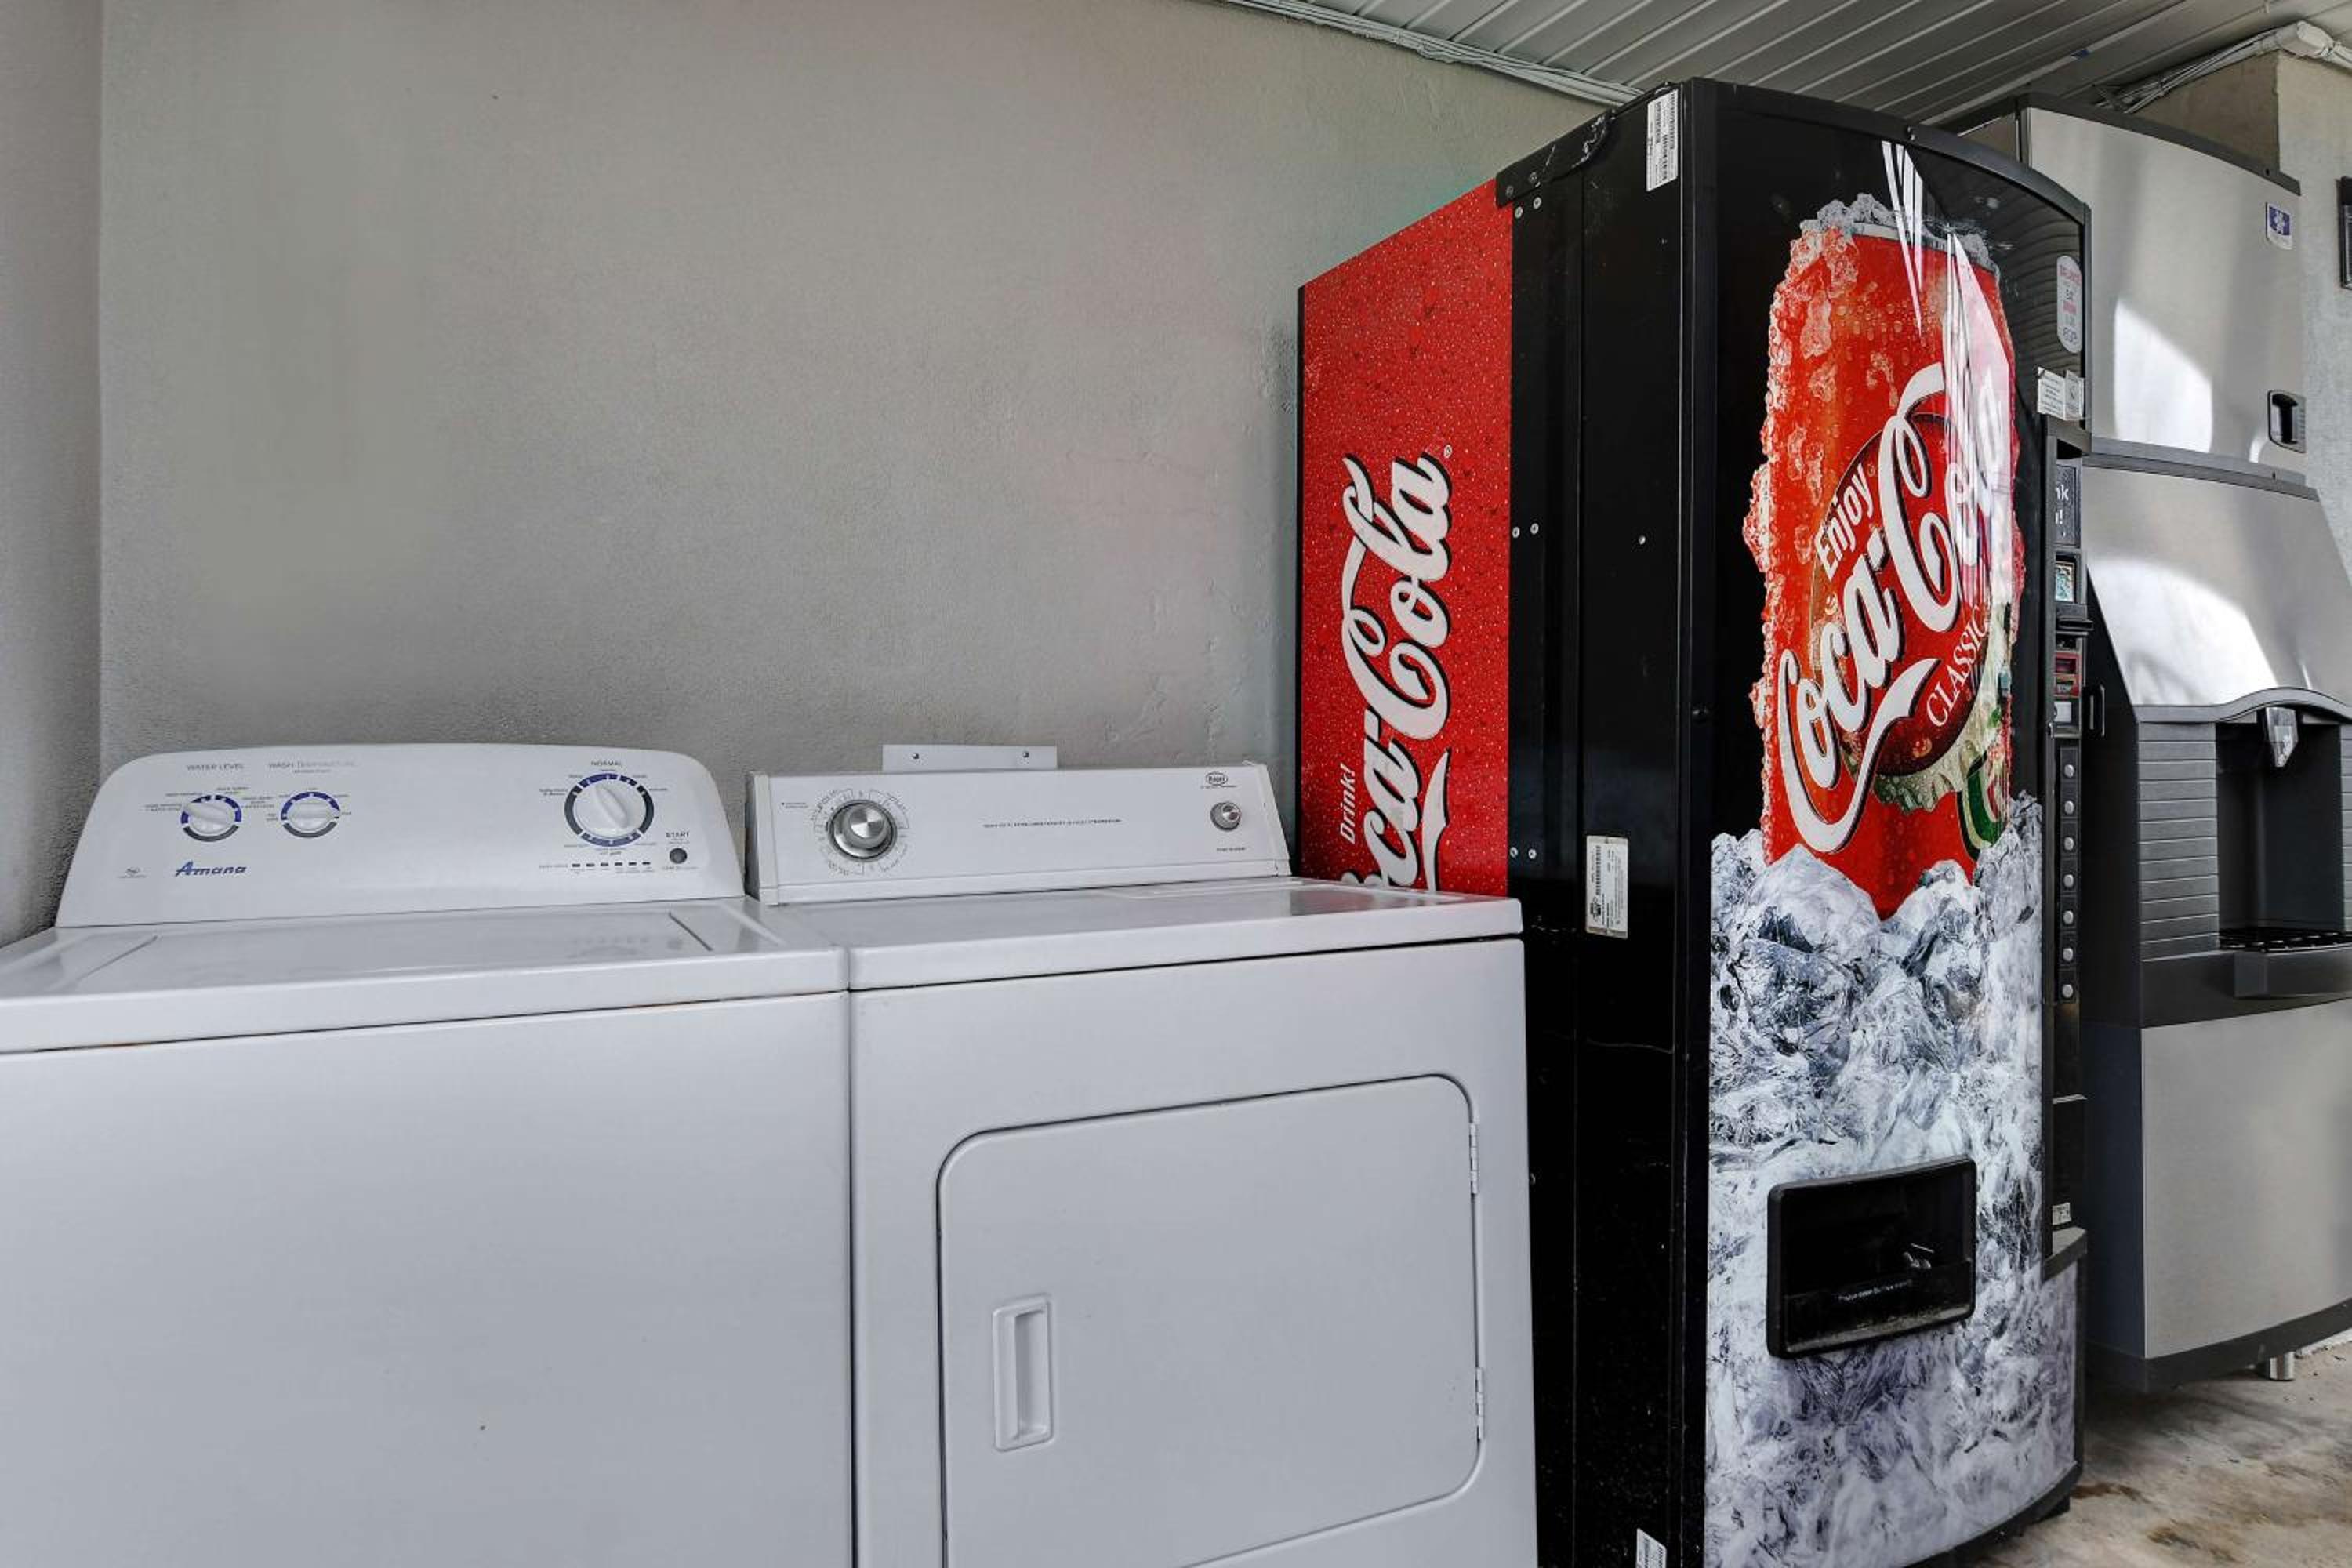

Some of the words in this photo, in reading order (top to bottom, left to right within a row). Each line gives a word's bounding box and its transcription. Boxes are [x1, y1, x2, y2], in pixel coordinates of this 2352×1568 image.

[1814, 462, 1874, 582] Enjoy
[1341, 453, 1451, 891] ca-Cola
[1926, 604, 1987, 727] CLASSIC
[1340, 762, 1356, 844] Drink!
[175, 860, 247, 877] Amana
